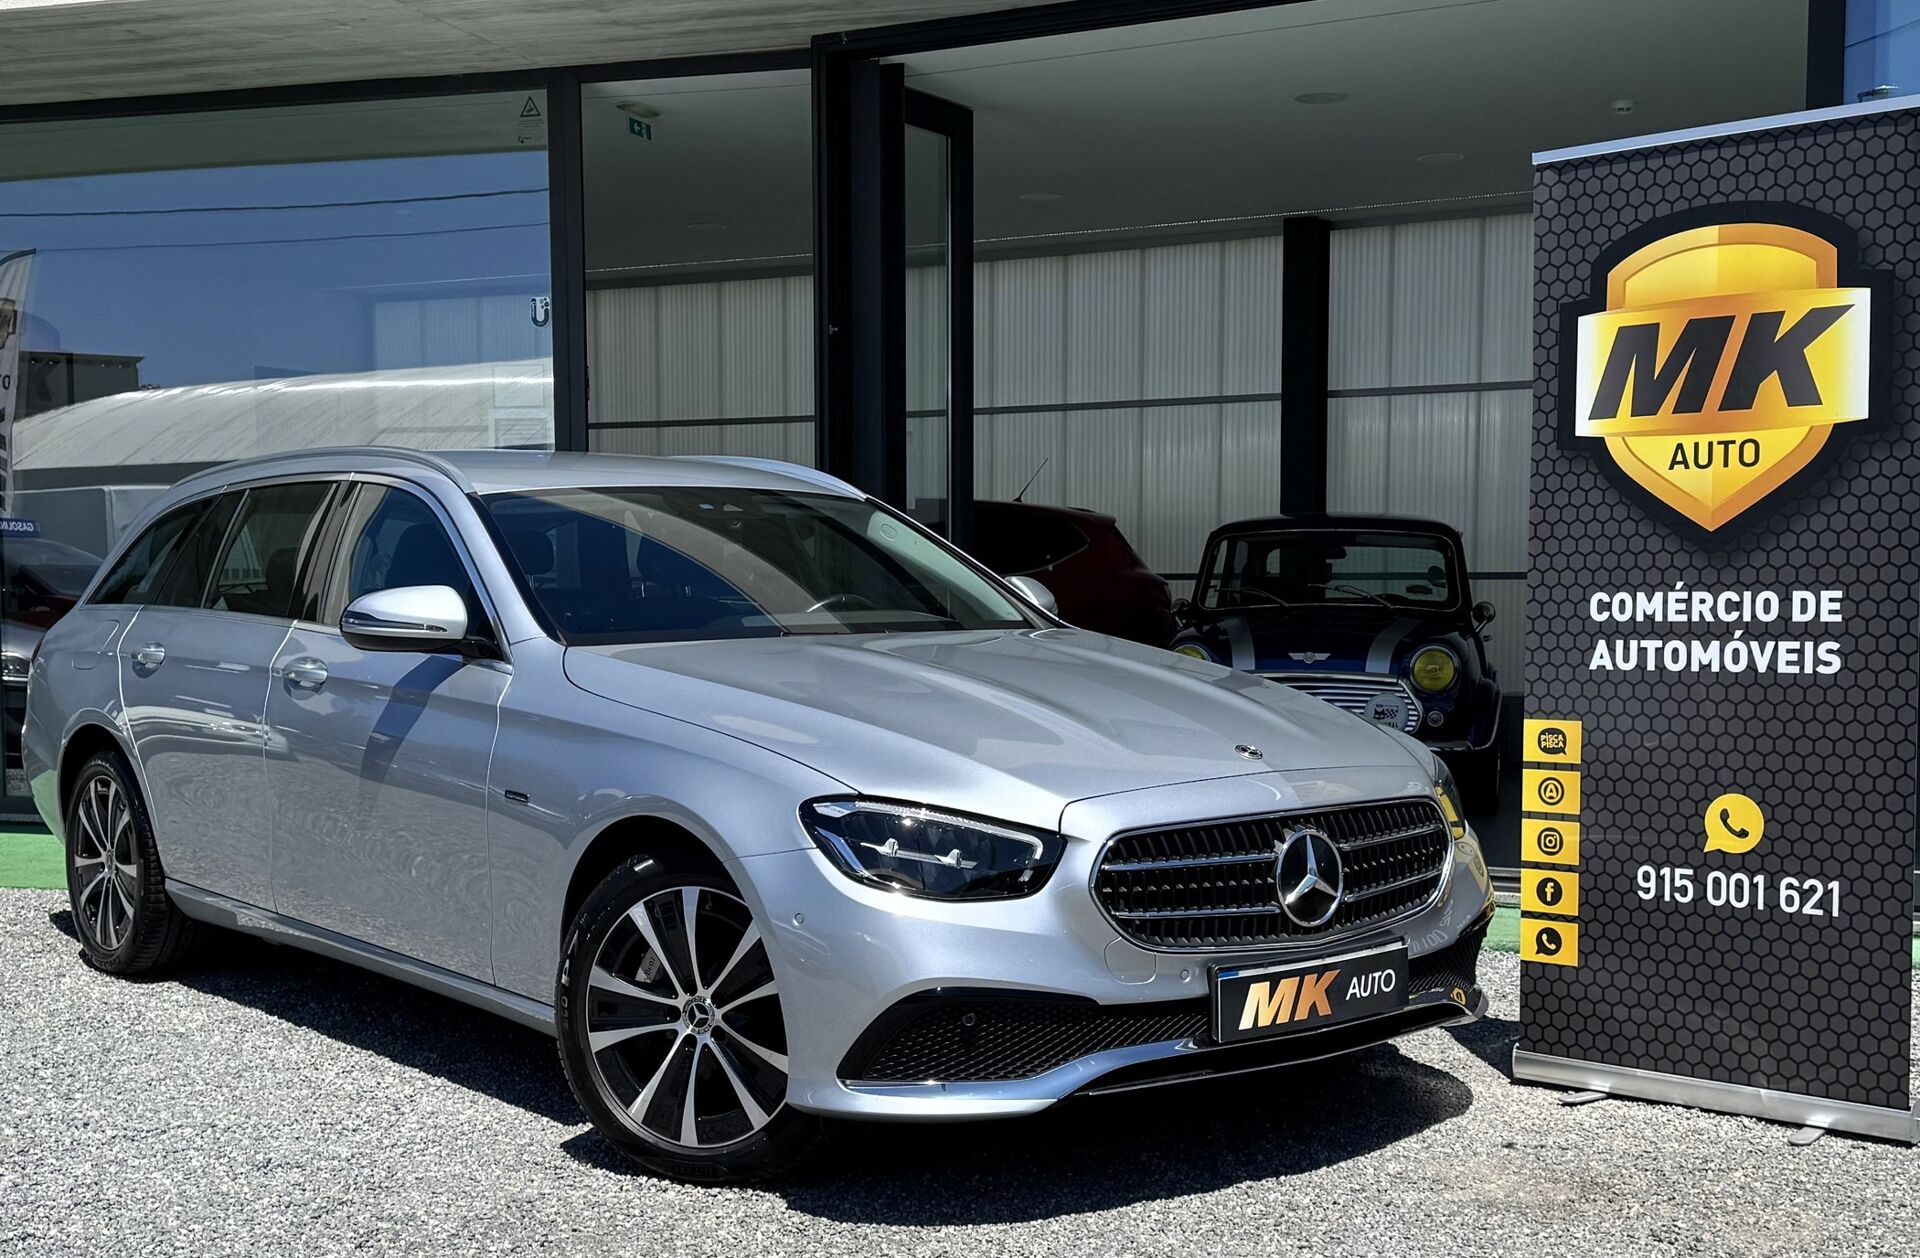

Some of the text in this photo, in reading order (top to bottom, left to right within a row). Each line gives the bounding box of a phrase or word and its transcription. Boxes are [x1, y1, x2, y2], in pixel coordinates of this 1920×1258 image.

[1588, 303, 1856, 421] MK
[1667, 438, 1760, 471] AUTO
[1589, 581, 1843, 623] COMÉRCIO DE
[1588, 629, 1842, 675] AUTOMÓVEIS
[1636, 865, 1840, 918] 915 001 621
[1238, 969, 1396, 1031] MK AUTO
